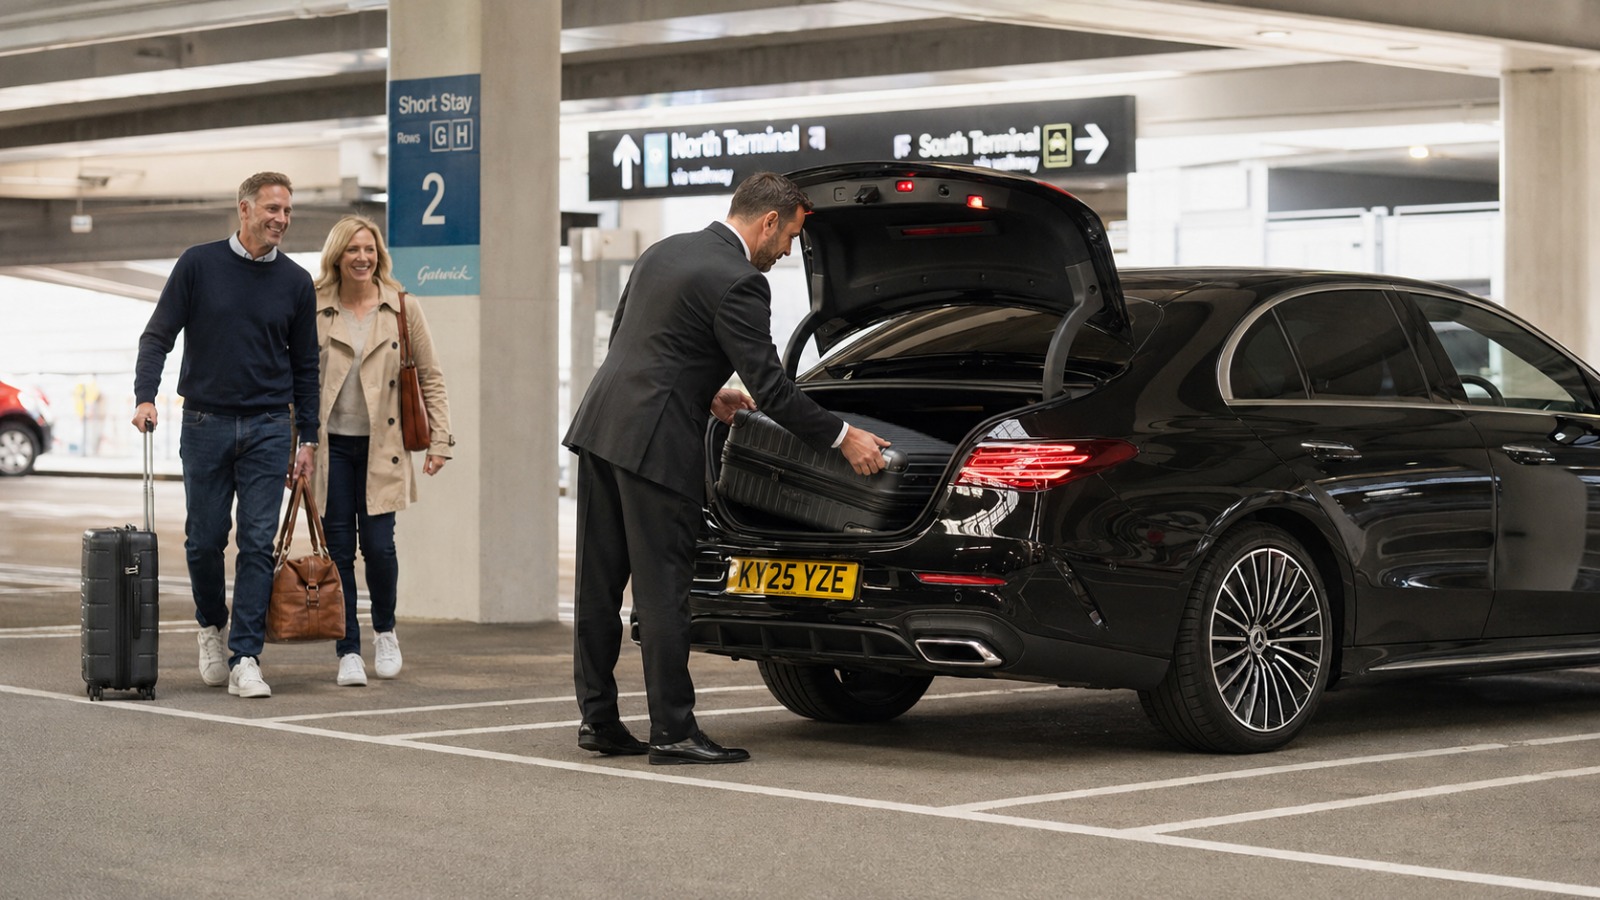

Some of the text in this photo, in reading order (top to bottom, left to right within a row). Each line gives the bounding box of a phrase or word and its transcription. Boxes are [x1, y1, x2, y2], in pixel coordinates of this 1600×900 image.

[398, 92, 472, 115] Short Stay
[396, 124, 468, 147] Rows G H
[671, 129, 722, 159] North
[722, 124, 800, 156] Terminal
[918, 130, 969, 158] South
[968, 125, 1041, 155] Terminal
[421, 171, 446, 226] 2
[737, 560, 849, 594] KY25 YZE
